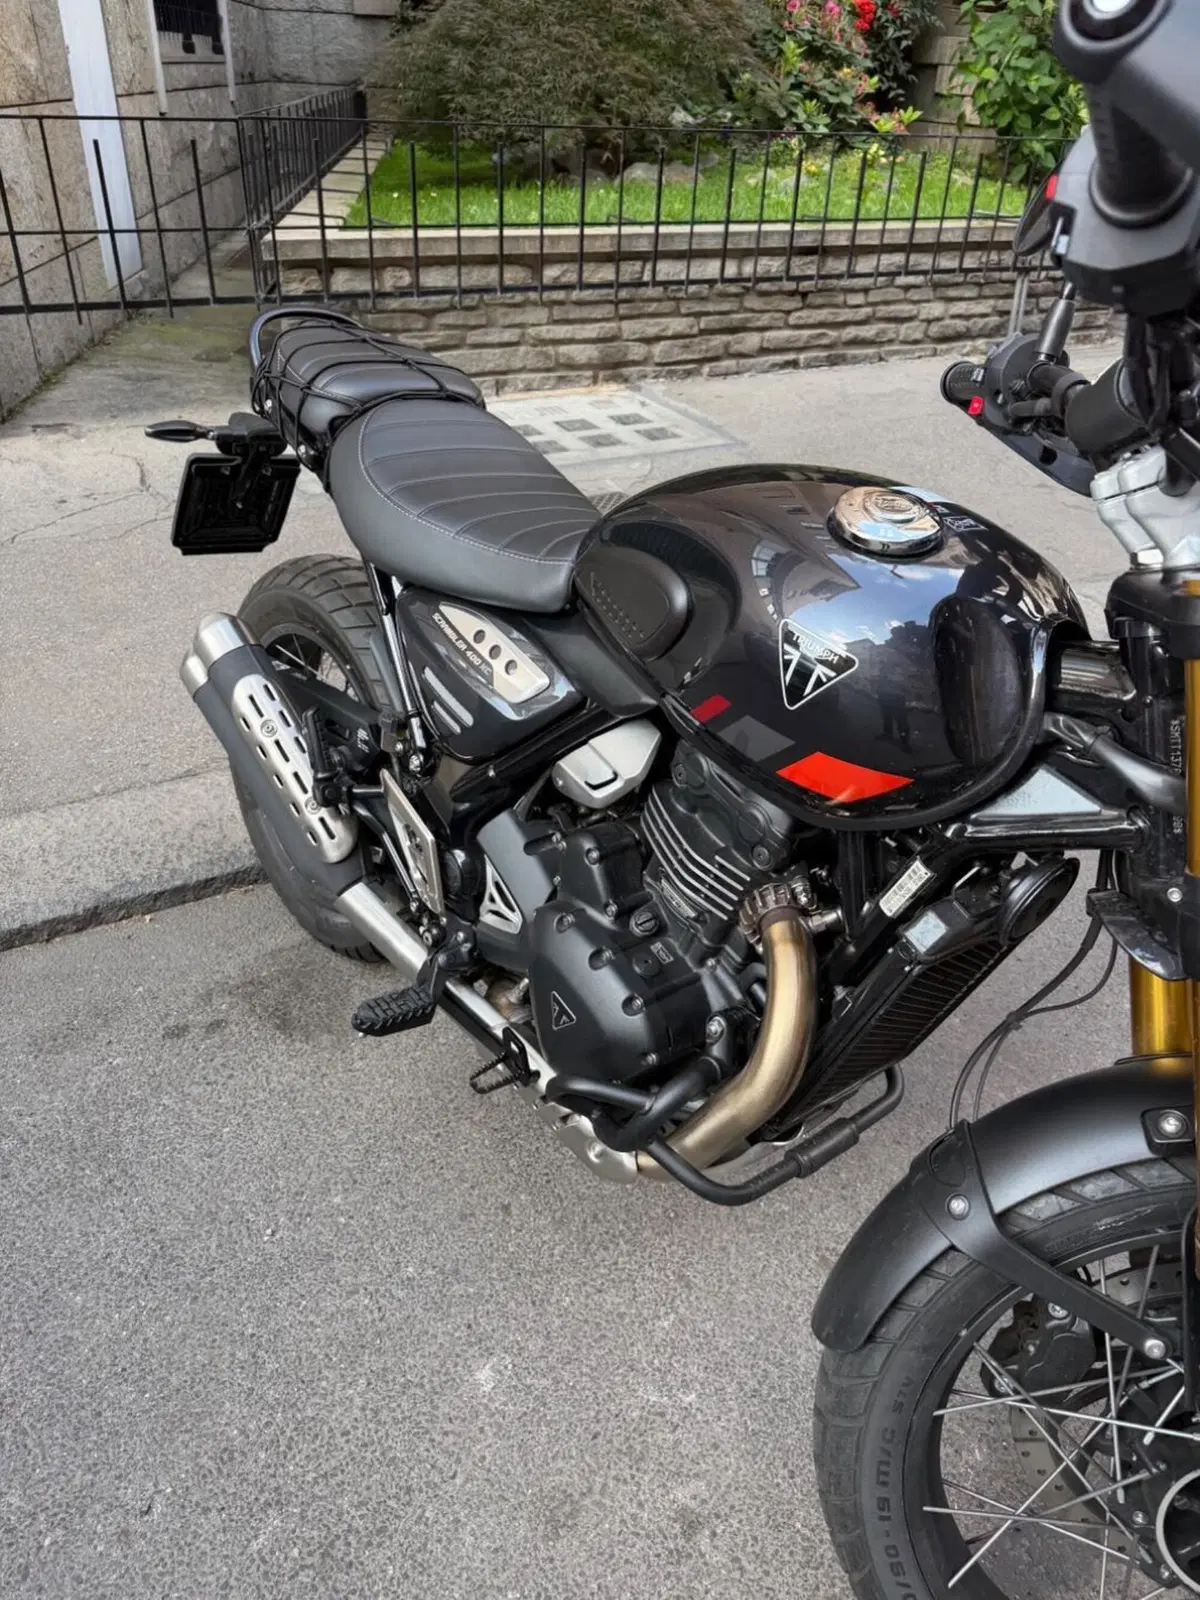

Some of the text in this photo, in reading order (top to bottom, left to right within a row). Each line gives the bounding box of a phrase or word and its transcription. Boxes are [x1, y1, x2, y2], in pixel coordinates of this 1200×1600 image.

[432, 612, 492, 676] SCRAMBLER 400 XC
[792, 632, 840, 665] TRIUMPH
[875, 1426, 897, 1488] M/C
